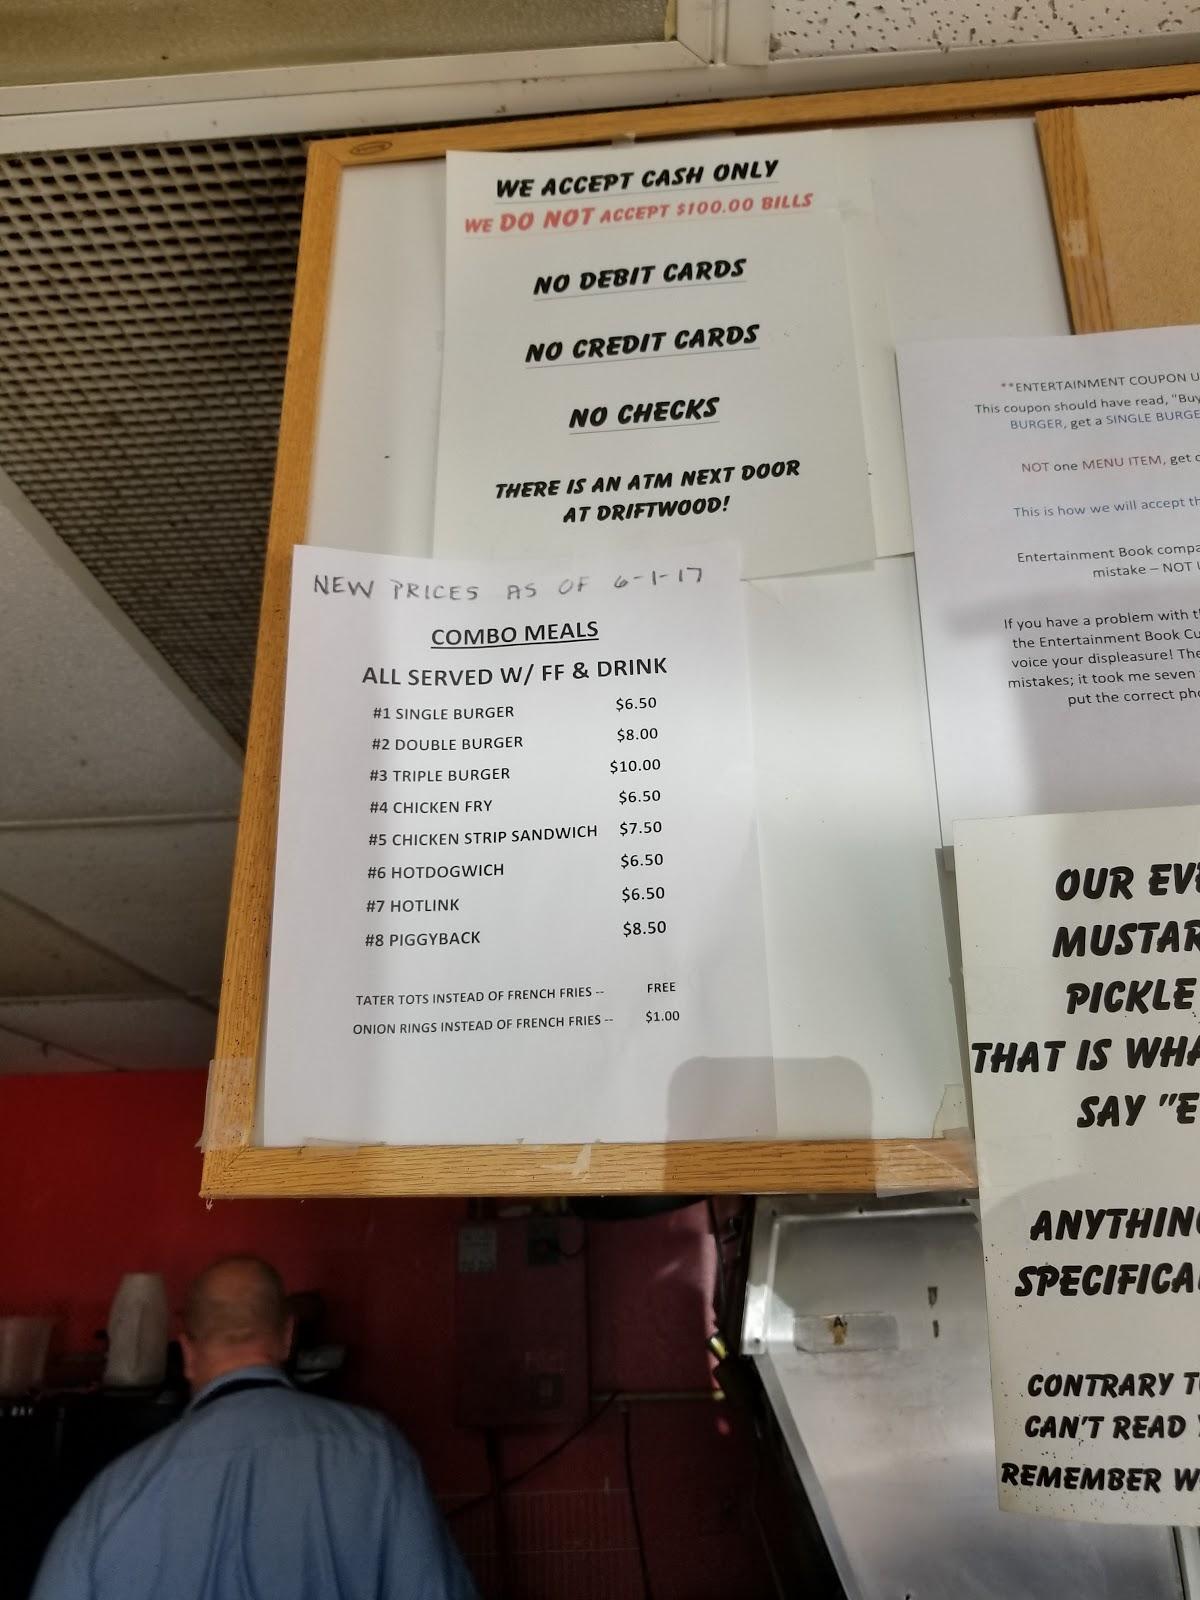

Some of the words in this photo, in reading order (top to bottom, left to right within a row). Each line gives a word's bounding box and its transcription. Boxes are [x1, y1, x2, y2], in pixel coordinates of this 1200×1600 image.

[497, 179, 534, 198] WE
[541, 172, 634, 196] ACCEPT
[642, 166, 704, 187] CASH
[713, 160, 778, 182] ONLY
[465, 218, 493, 233] WE
[500, 212, 534, 232] DO
[543, 207, 595, 228] NOT
[600, 204, 670, 223] ACCEPT
[677, 198, 753, 216] $100.00
[762, 193, 813, 210] BILLS
[534, 274, 570, 295] NO
[580, 266, 655, 290] DEBIT
[663, 258, 746, 282] CARDS
[525, 342, 563, 362] NO
[573, 332, 666, 358] CREDIT
[675, 324, 760, 349] CARDS
[1129, 373, 1187, 386] COUPON
[569, 407, 607, 428] NO
[618, 397, 720, 424] CHECKS
[974, 403, 1001, 414] This
[1004, 403, 1051, 416] coupon
[1053, 399, 1097, 412] should
[1101, 397, 1132, 409] have
[1135, 394, 1169, 407] read,
[1010, 418, 1067, 430] BURGER,
[1070, 417, 1092, 431] get
[1094, 417, 1103, 426] a
[1105, 412, 1152, 425] SINGLE
[1021, 461, 1050, 473] NOT
[1053, 462, 1078, 471] one
[1082, 457, 1125, 471] MENU
[1128, 455, 1167, 467] ITEM,
[1169, 453, 1192, 466] get
[496, 480, 561, 498] THERE
[567, 478, 587, 494] IS
[592, 476, 621, 492] AN
[628, 473, 672, 490] ATM
[681, 467, 735, 486] NEXT
[742, 460, 800, 481] DOOR
[563, 506, 591, 523] AT
[597, 496, 730, 521] DRIFTWOOD!
[1012, 506, 1040, 518] This
[1044, 506, 1053, 517] is
[1058, 504, 1086, 516] how
[1089, 504, 1111, 514] we
[1113, 499, 1137, 512] will
[1141, 497, 1186, 510] accept
[1017, 549, 1116, 563] Entertainment
[1118, 544, 1154, 558] Book
[1092, 564, 1147, 578] mistake
[1162, 561, 1193, 573] NOT
[314, 575, 374, 598] NEW
[390, 579, 479, 600] PRICES
[507, 583, 536, 600] AS
[558, 577, 588, 595] OF
[614, 567, 702, 588] 6-1-17
[1004, 617, 1013, 630] If
[1016, 619, 1042, 632] you
[1045, 616, 1079, 628] have
[1082, 617, 1091, 626] a
[1095, 611, 1154, 628] problem
[1157, 608, 1189, 621] with
[431, 627, 517, 646] COMBO
[525, 621, 599, 641] MEALS
[1012, 636, 1036, 649] the
[1039, 632, 1141, 648] Entertainment
[1144, 629, 1181, 642] Book
[1011, 658, 1048, 669] voice
[1051, 656, 1084, 669] your
[1087, 648, 1174, 666] displeasure!
[362, 667, 401, 684] ALL
[408, 669, 492, 686] SERVED
[500, 664, 534, 685] W/
[543, 664, 564, 681] FF
[573, 662, 589, 679] &
[598, 658, 667, 677] DRINK
[1008, 675, 1074, 688] mistakes;
[1078, 673, 1087, 684] it
[1091, 671, 1125, 684] took
[1127, 672, 1151, 682] me
[1154, 670, 1196, 681] seven
[373, 708, 390, 719] #1
[396, 709, 448, 720] SINGLE
[454, 706, 514, 719] BURGER
[616, 697, 656, 712] $6.50
[1067, 693, 1093, 708] put
[1094, 691, 1120, 704] the
[1123, 689, 1176, 702] correct
[1178, 687, 1200, 702] ph
[372, 738, 389, 750] #2
[396, 739, 456, 750] DOUBLE
[462, 737, 523, 749] BURGER
[618, 728, 658, 743] $8.00
[370, 770, 387, 781] #3
[393, 771, 442, 782] TRIPLE
[449, 768, 510, 781] BURGER
[611, 759, 660, 774] $10.00
[369, 801, 388, 813] #4
[392, 800, 459, 813] CHICKEN
[465, 799, 492, 812] FRY
[618, 789, 660, 805] $6.50
[368, 833, 386, 845] #5
[392, 832, 458, 846] CHICKEN
[464, 831, 506, 844] STRIP
[511, 824, 597, 842] SANDWICH
[619, 820, 661, 836] $7.50
[367, 866, 385, 879] #6
[391, 863, 503, 878] HOTDOGWICH
[620, 853, 663, 869] $6.50
[1056, 866, 1134, 901] OUR
[1149, 862, 1200, 896] EV
[365, 899, 384, 912] #7
[390, 898, 459, 912] HOTLINK
[621, 886, 664, 903] $6.50
[364, 933, 384, 947] #8
[389, 930, 480, 946] PIGGYBACK
[623, 920, 666, 937] $8.50
[355, 994, 394, 1005] TATER
[397, 993, 428, 1004] TOTS
[432, 991, 484, 1003] INSTEAD
[487, 990, 504, 1001] OF
[507, 988, 555, 1000] FRENCH
[559, 986, 592, 998] FRIES
[647, 981, 675, 993] FREE
[1066, 978, 1197, 1014] PICKLE
[352, 1023, 395, 1034] ONION
[399, 1022, 437, 1033] RINGS
[440, 1019, 492, 1032] INSTEAD
[496, 1018, 512, 1029] OF
[516, 1015, 565, 1030] FRENCH
[568, 1014, 601, 1026] FRIES
[645, 1009, 679, 1023] $1.00
[972, 1041, 1066, 1073] THAT
[1076, 1039, 1112, 1071] IS
[1077, 1095, 1146, 1128] SAY
[1030, 1206, 1200, 1241] ANYTHIN
[1015, 1262, 1200, 1297] SPECIFICA
[1028, 1373, 1174, 1398] CONTRARY
[1184, 1372, 1200, 1395] T
[1025, 1415, 1104, 1439] CAN'T
[1113, 1415, 1186, 1440] READ
[1001, 1462, 1161, 1493] REMEMBER
[1174, 1468, 1200, 1491] W
